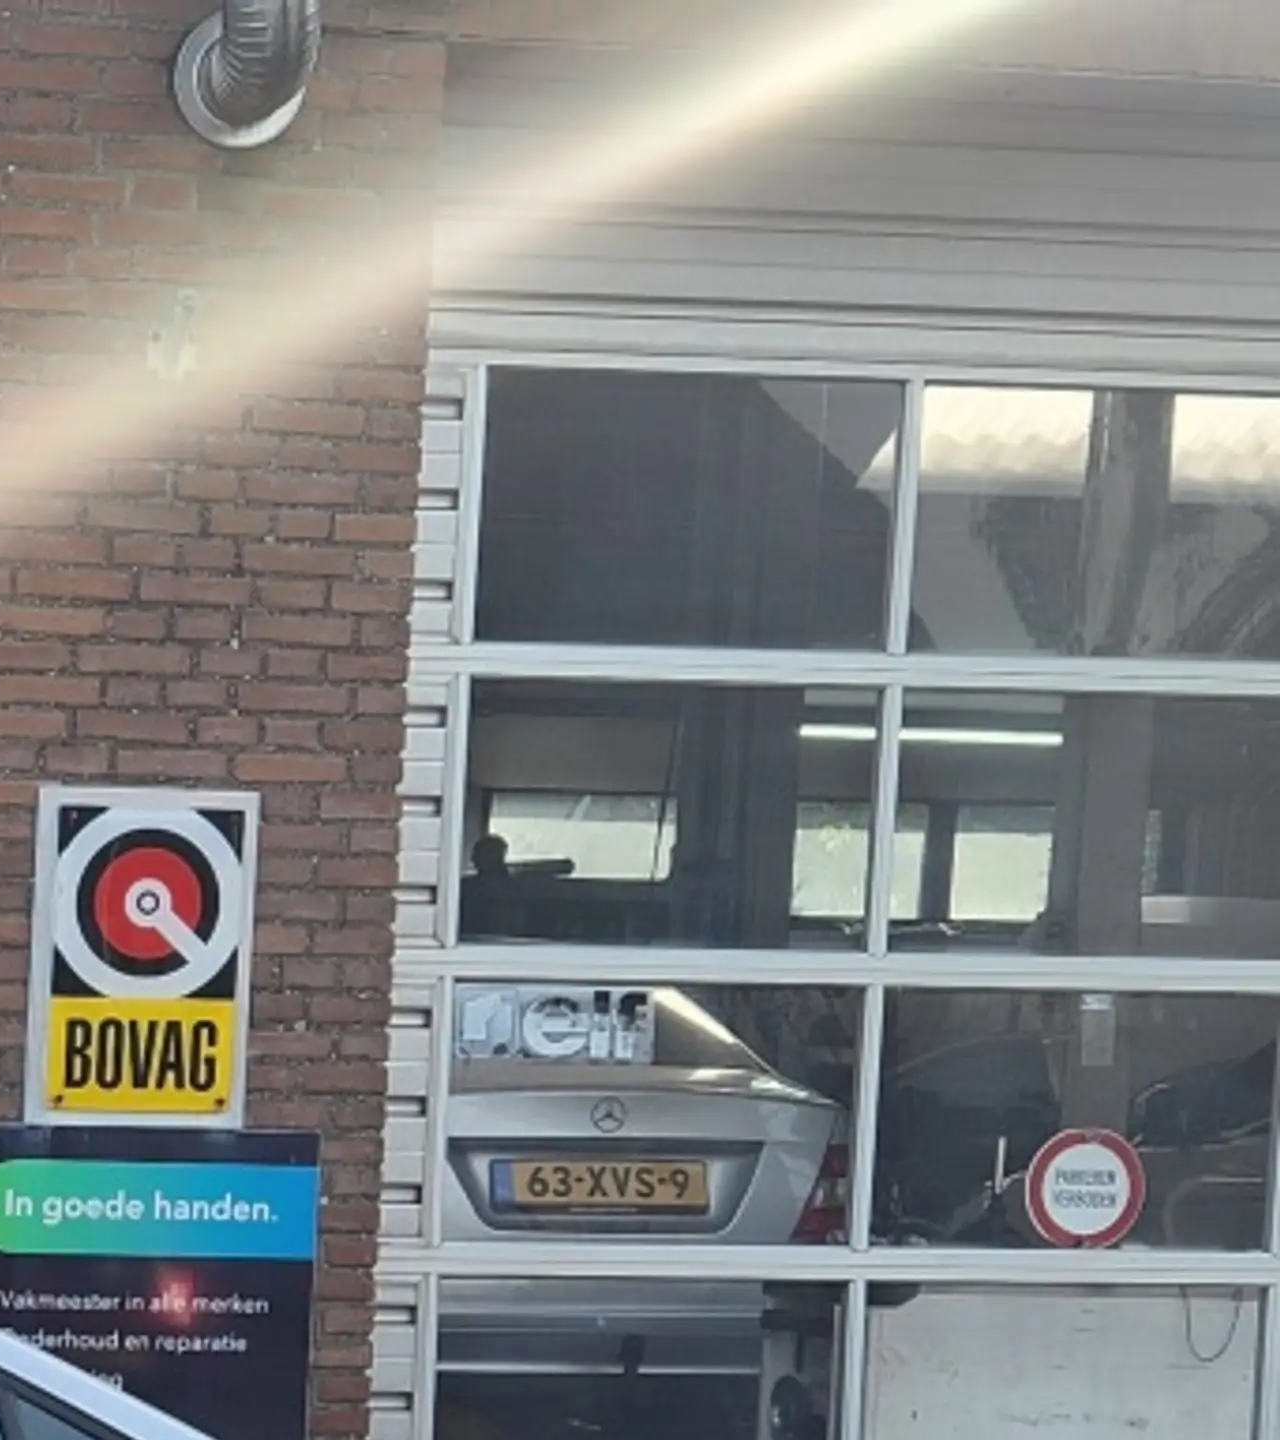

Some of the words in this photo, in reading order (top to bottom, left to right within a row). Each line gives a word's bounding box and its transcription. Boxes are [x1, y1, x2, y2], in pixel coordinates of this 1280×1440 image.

[65, 1017, 219, 1091] BOVAG
[526, 1166, 690, 1199] 63-XVS-9
[4, 1190, 33, 1218] In
[42, 1191, 145, 1226] goede
[155, 1190, 280, 1222] handen.
[125, 1292, 145, 1311] in
[149, 1291, 186, 1312] alle
[193, 1292, 270, 1315] merken
[124, 1334, 150, 1352] en
[154, 1332, 248, 1356] reparatie
